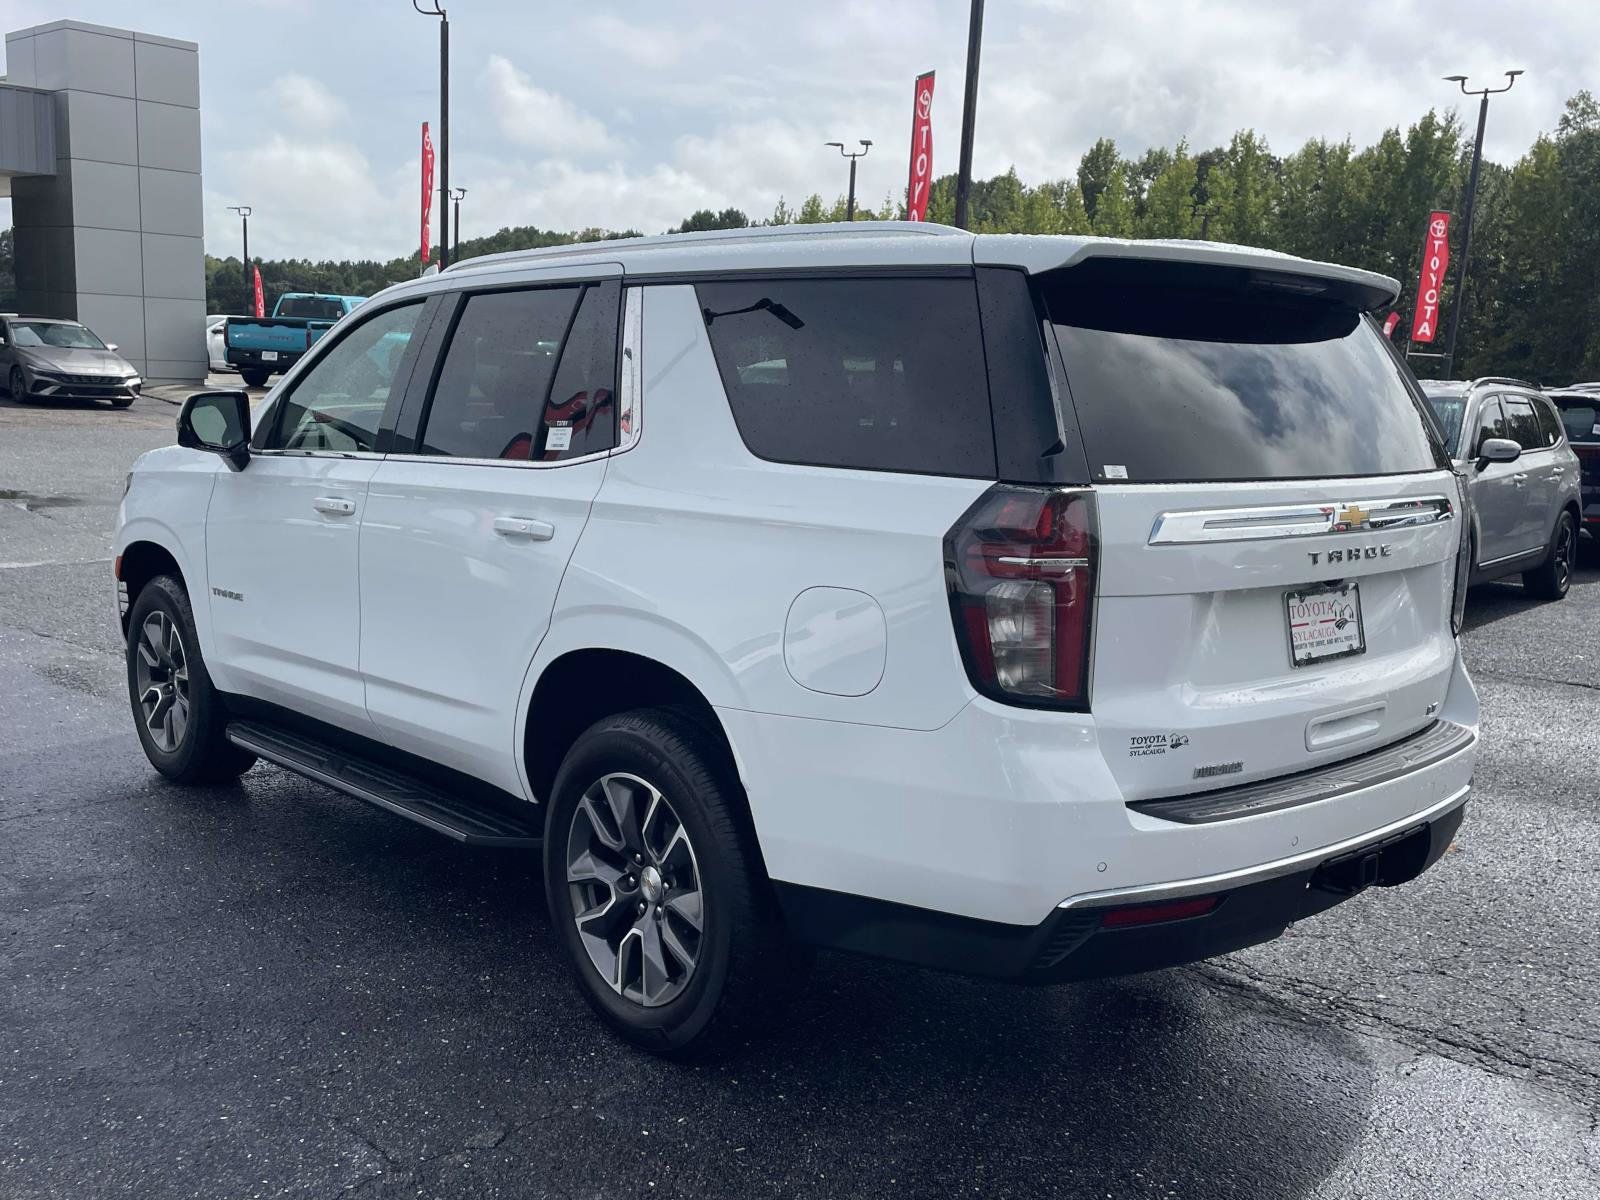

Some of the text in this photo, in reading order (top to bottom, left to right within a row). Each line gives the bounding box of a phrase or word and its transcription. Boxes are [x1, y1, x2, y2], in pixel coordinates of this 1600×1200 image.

[1417, 240, 1443, 336] TOYOTA
[1308, 544, 1392, 565] TAHOE
[1290, 601, 1334, 619] TOYOTA
[1294, 627, 1336, 641] SYLACAUGA
[1131, 735, 1167, 745] TOYOTA
[1129, 748, 1166, 757] SYLACAUGA
